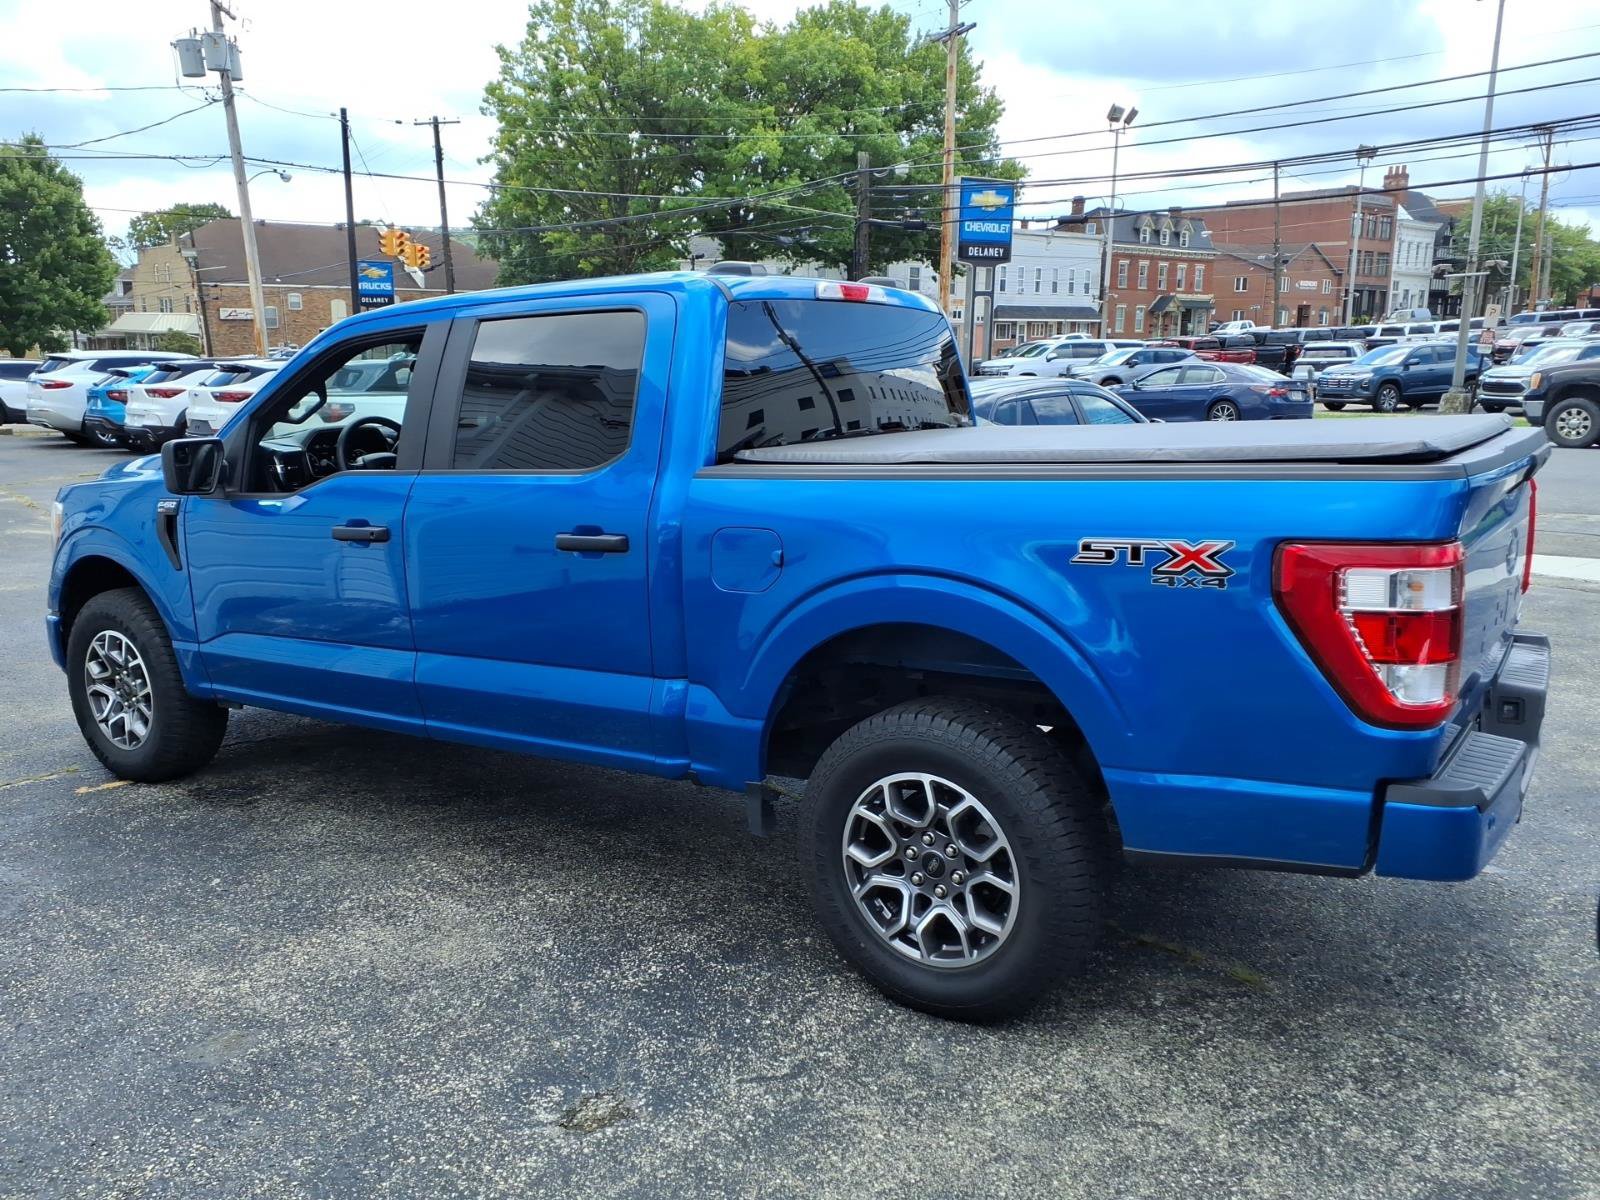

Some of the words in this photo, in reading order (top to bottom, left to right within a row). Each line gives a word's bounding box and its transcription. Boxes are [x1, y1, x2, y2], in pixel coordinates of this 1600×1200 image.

[964, 221, 1010, 233] CHEVROLET
[968, 246, 1004, 257] DELANEY
[358, 282, 392, 290] TRUCKS
[1069, 537, 1237, 577] STX
